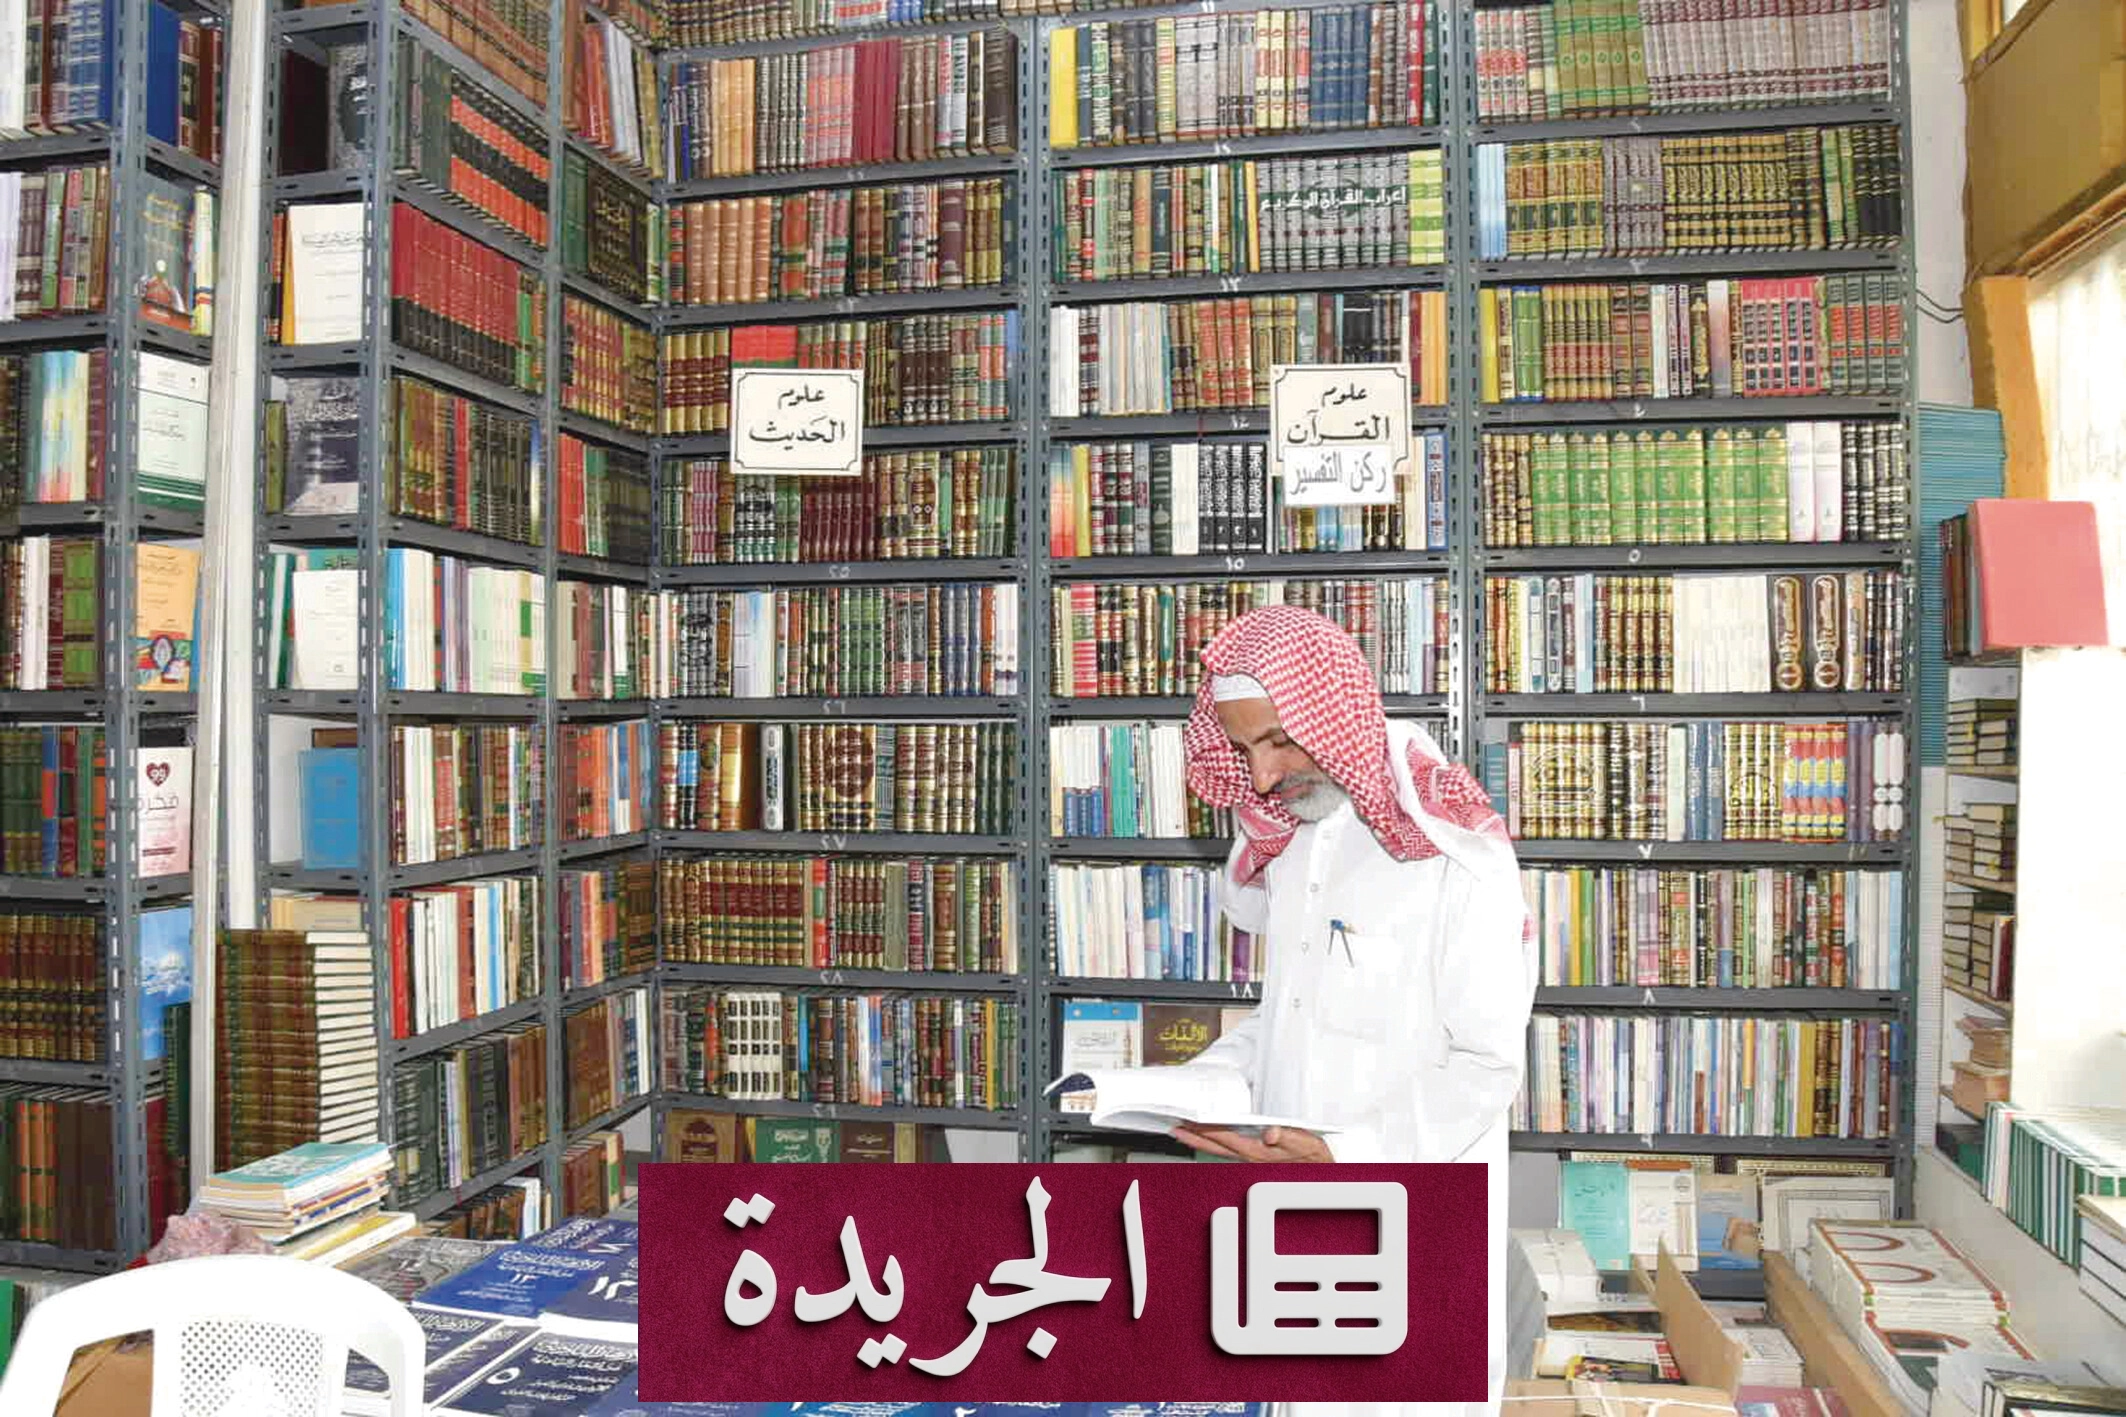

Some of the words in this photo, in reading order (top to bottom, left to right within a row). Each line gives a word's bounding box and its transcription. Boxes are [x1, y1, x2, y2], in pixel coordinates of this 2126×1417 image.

[778, 384, 825, 410] علوم
[1322, 383, 1367, 407] علوم
[1289, 451, 1343, 495] التفسير
[1350, 451, 1387, 493] ركن
[1225, 556, 1245, 571] ١٥
[821, 835, 847, 850] ٢٧
[1637, 843, 1653, 859] ٧
[820, 970, 843, 985] ٢٨
[1230, 984, 1255, 998] ١٨
[1643, 988, 1656, 1006] ٨
